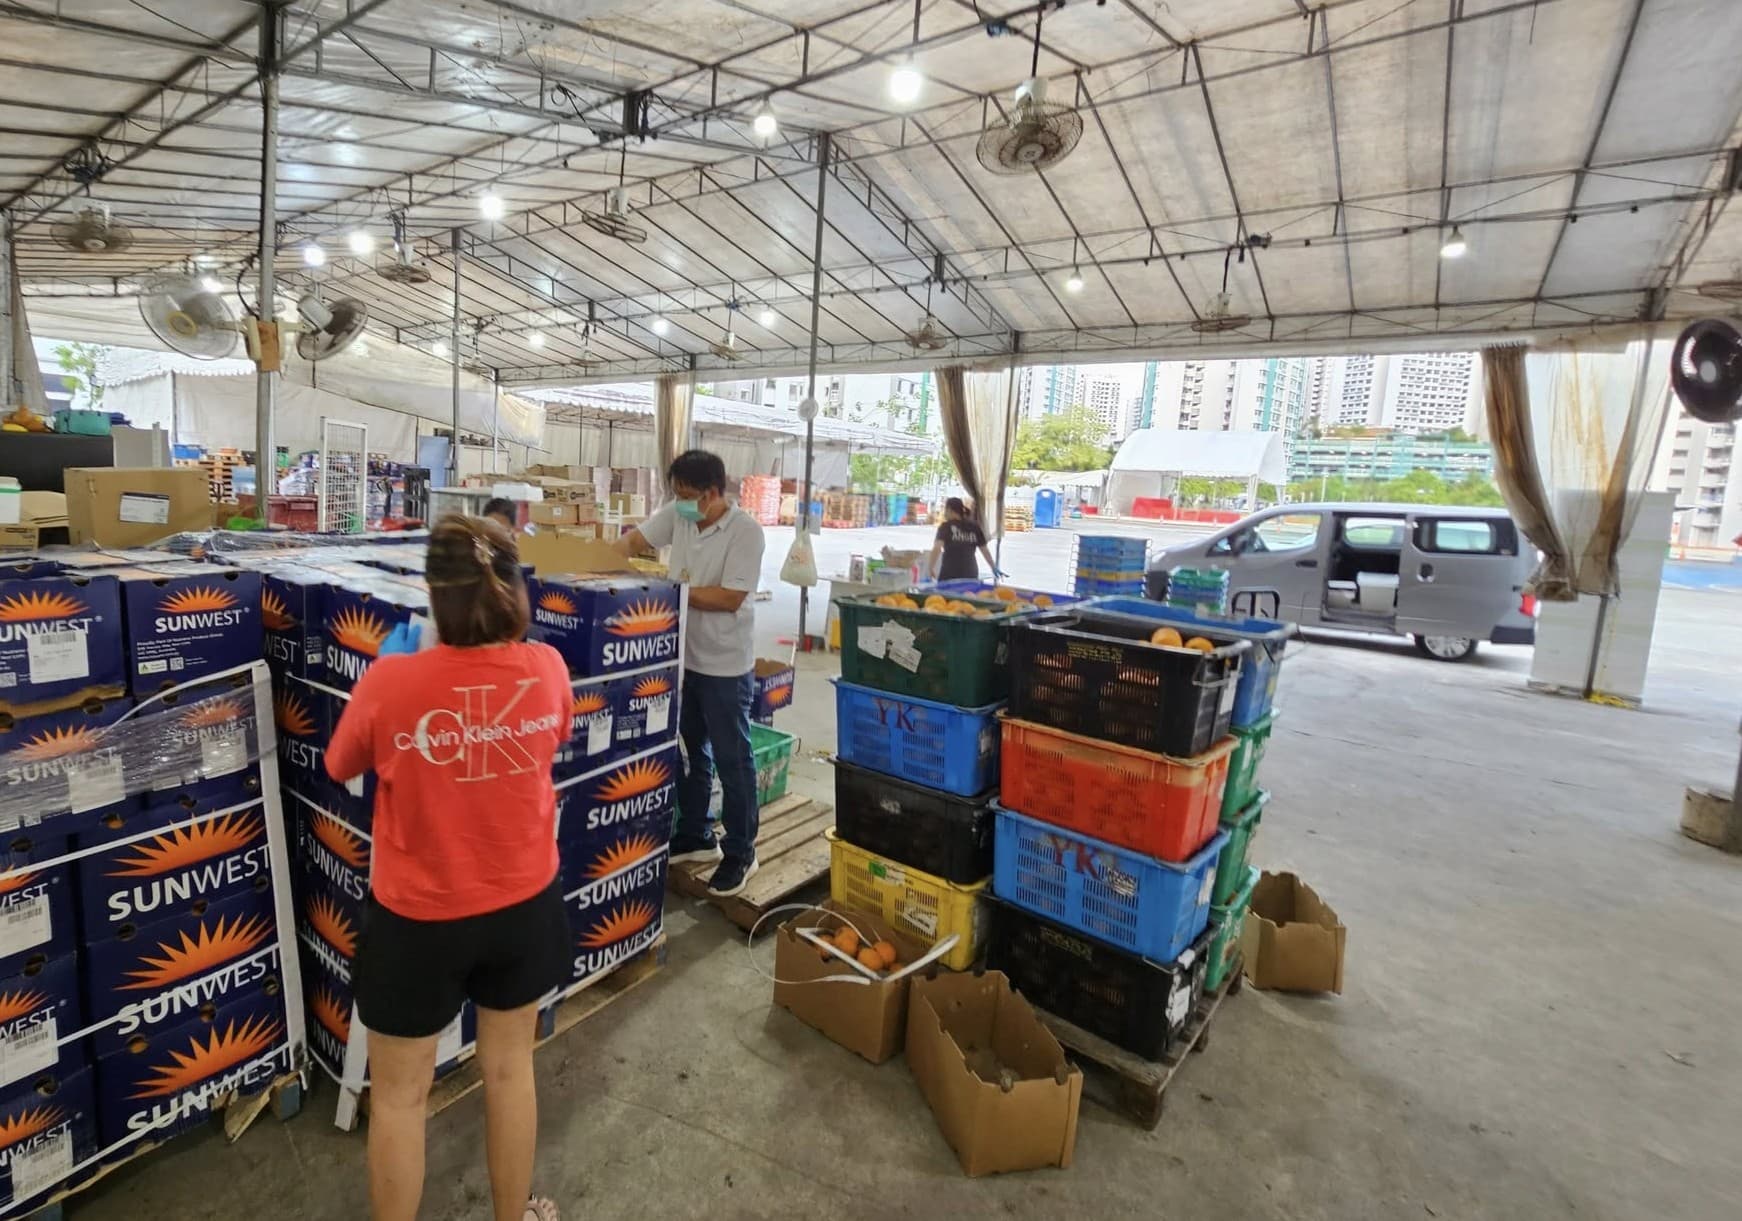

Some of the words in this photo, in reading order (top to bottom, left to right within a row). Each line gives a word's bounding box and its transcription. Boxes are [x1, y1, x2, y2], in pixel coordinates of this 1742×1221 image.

[155, 609, 242, 633] SUNWEST
[535, 608, 579, 630] SUNWEST
[602, 633, 679, 667] SUNWEST
[394, 728, 459, 750] Cavin
[464, 724, 511, 745] Klein
[587, 783, 672, 830] SUNWEST
[0, 882, 48, 909] EST
[108, 845, 270, 922] SUNWEST
[578, 859, 662, 910] SUNWEST
[573, 922, 657, 977] SUNWEST
[117, 947, 279, 1035] SUNWEST
